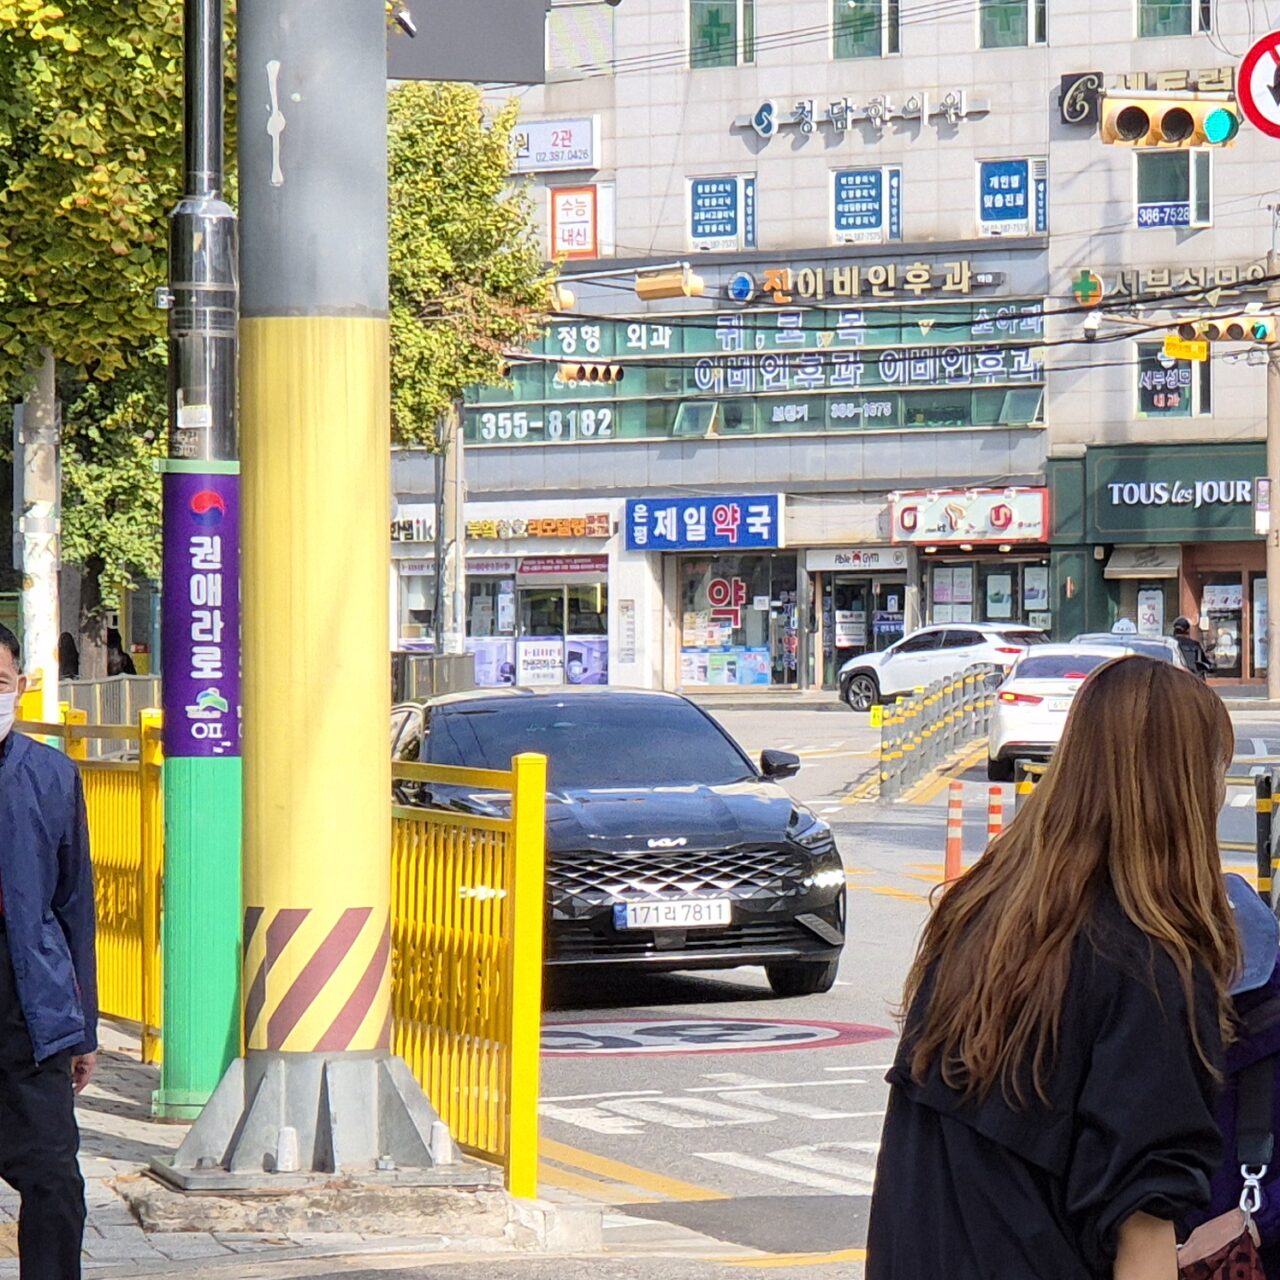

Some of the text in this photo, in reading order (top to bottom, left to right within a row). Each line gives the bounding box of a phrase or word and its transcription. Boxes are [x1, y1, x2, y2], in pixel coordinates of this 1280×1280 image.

[552, 129, 573, 148] 2관
[561, 198, 586, 216] 수능
[1138, 207, 1190, 224] 386-7528
[561, 228, 587, 246] 내신
[762, 260, 973, 304] 진이비인후과
[557, 325, 600, 353] 정형
[627, 324, 672, 350] 외과
[695, 346, 1044, 391] 이비인후과 이비인후과
[1139, 368, 1191, 390] 서부성모
[481, 408, 613, 441] 355-8182
[1108, 480, 1252, 508] TOUS les JOUR
[653, 503, 771, 543] 제일약국
[708, 578, 746, 629] 약
[682, 903, 724, 922] 7811
